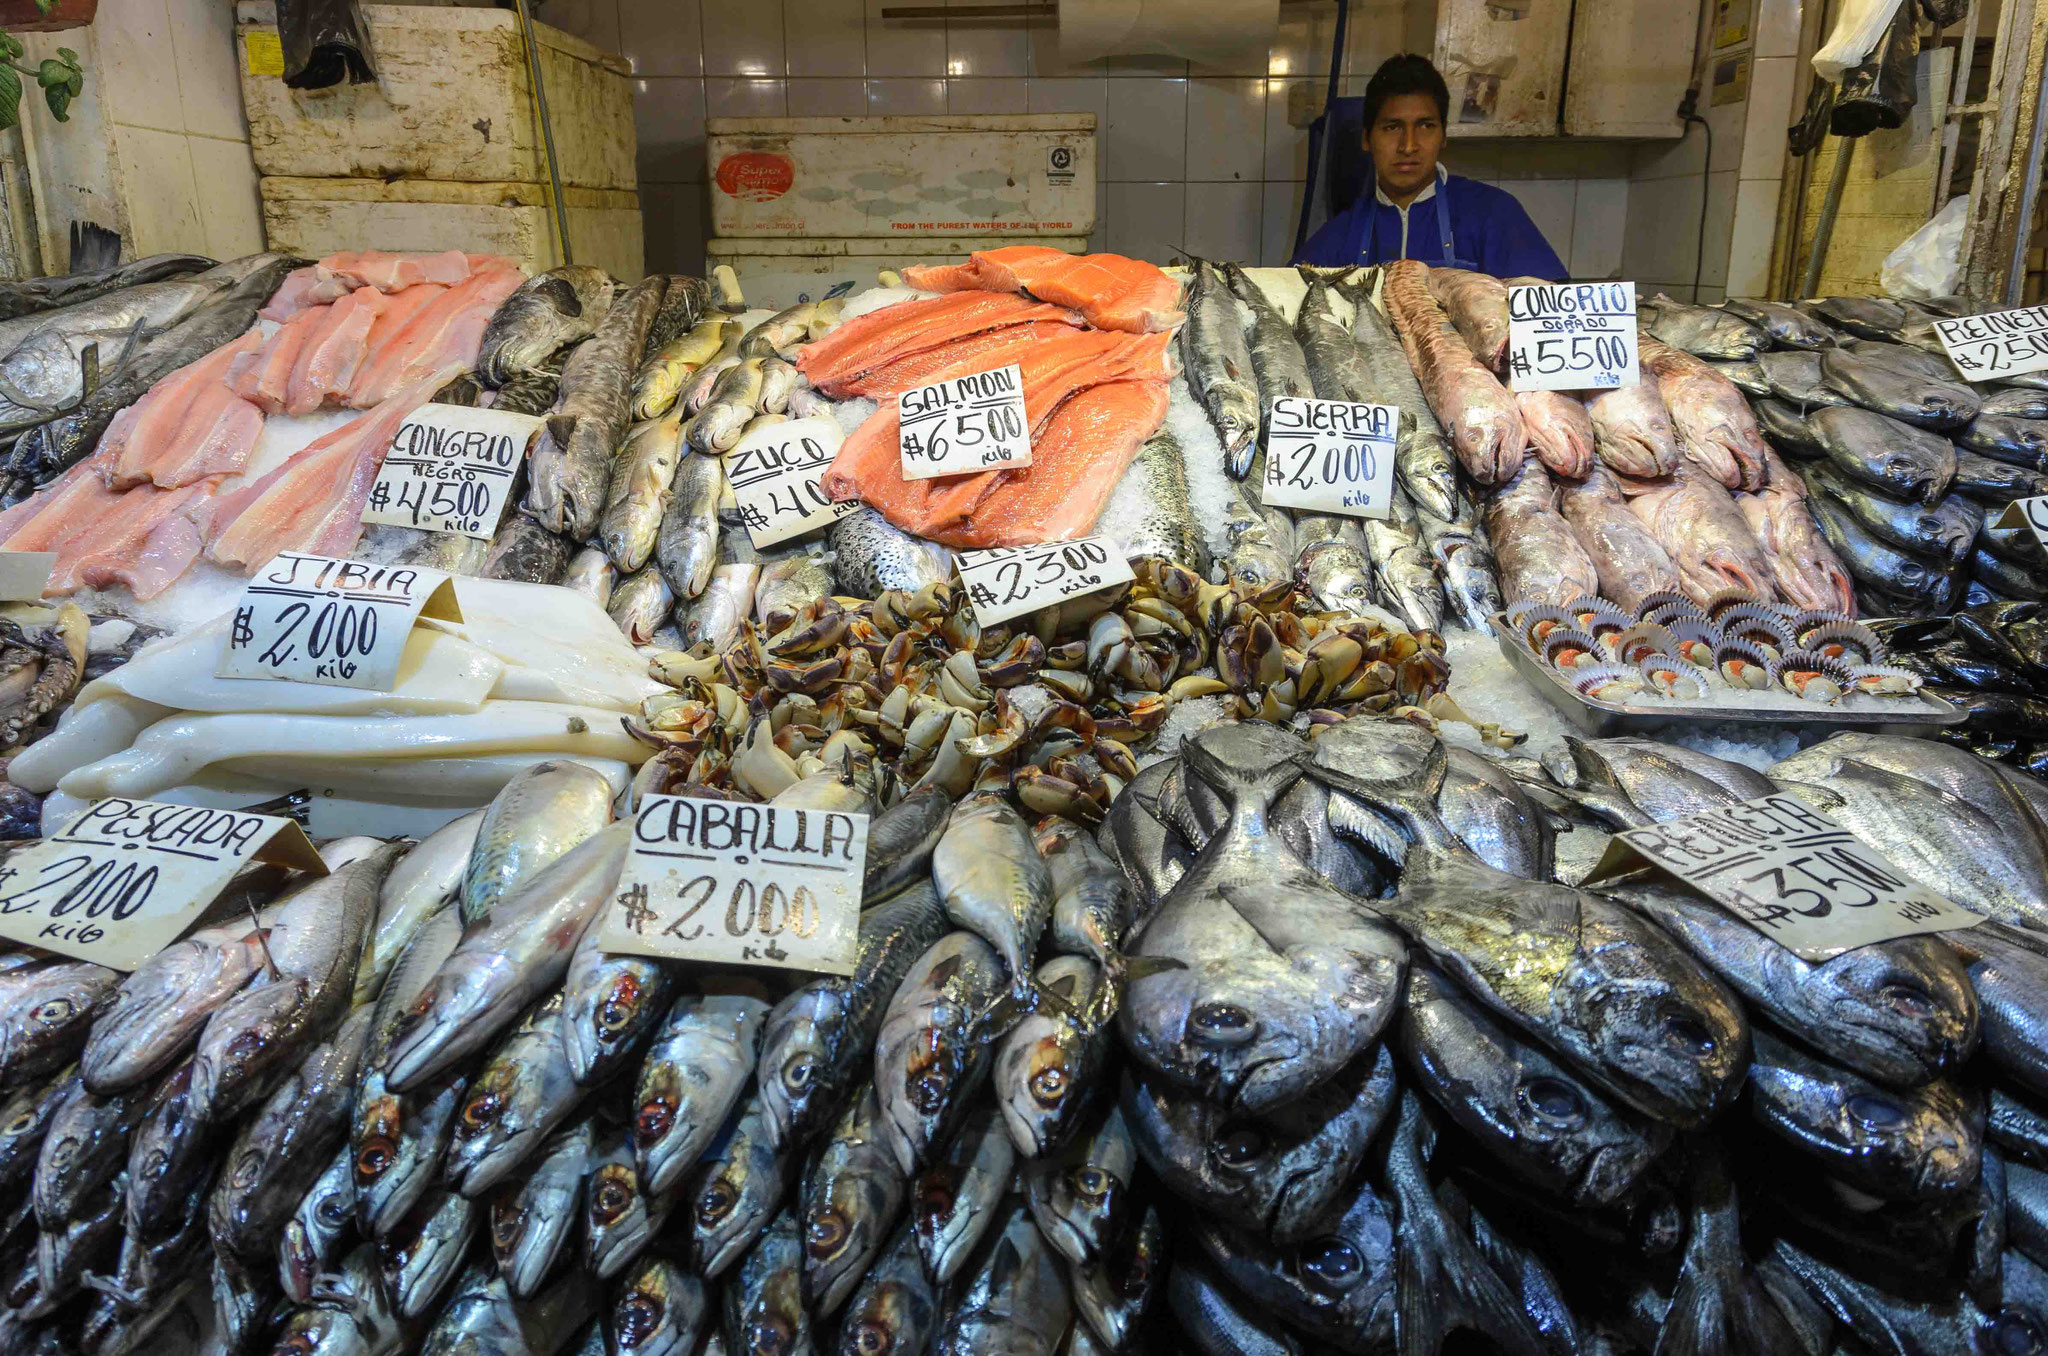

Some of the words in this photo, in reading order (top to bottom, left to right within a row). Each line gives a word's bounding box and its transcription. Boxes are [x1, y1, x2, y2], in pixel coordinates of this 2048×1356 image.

[740, 164, 783, 177] Super
[891, 222, 916, 230] FROM
[917, 222, 935, 230] THE
[936, 222, 970, 230] PUREST
[972, 221, 1007, 230] WATERS
[1009, 222, 1022, 230] OF
[1041, 221, 1073, 229] WORLD
[1510, 283, 1627, 318] CONGRIO
[1542, 317, 1608, 330] DORADO
[901, 368, 1016, 417] SALMON
[1274, 398, 1393, 437] SIERRA
[393, 423, 514, 467] CONGRIO
[727, 437, 825, 479] ZUCO
[412, 463, 476, 482] NEGRO
[268, 553, 418, 596] JIBIA
[66, 798, 264, 856] PESCADA
[635, 798, 854, 861] CABALLA
